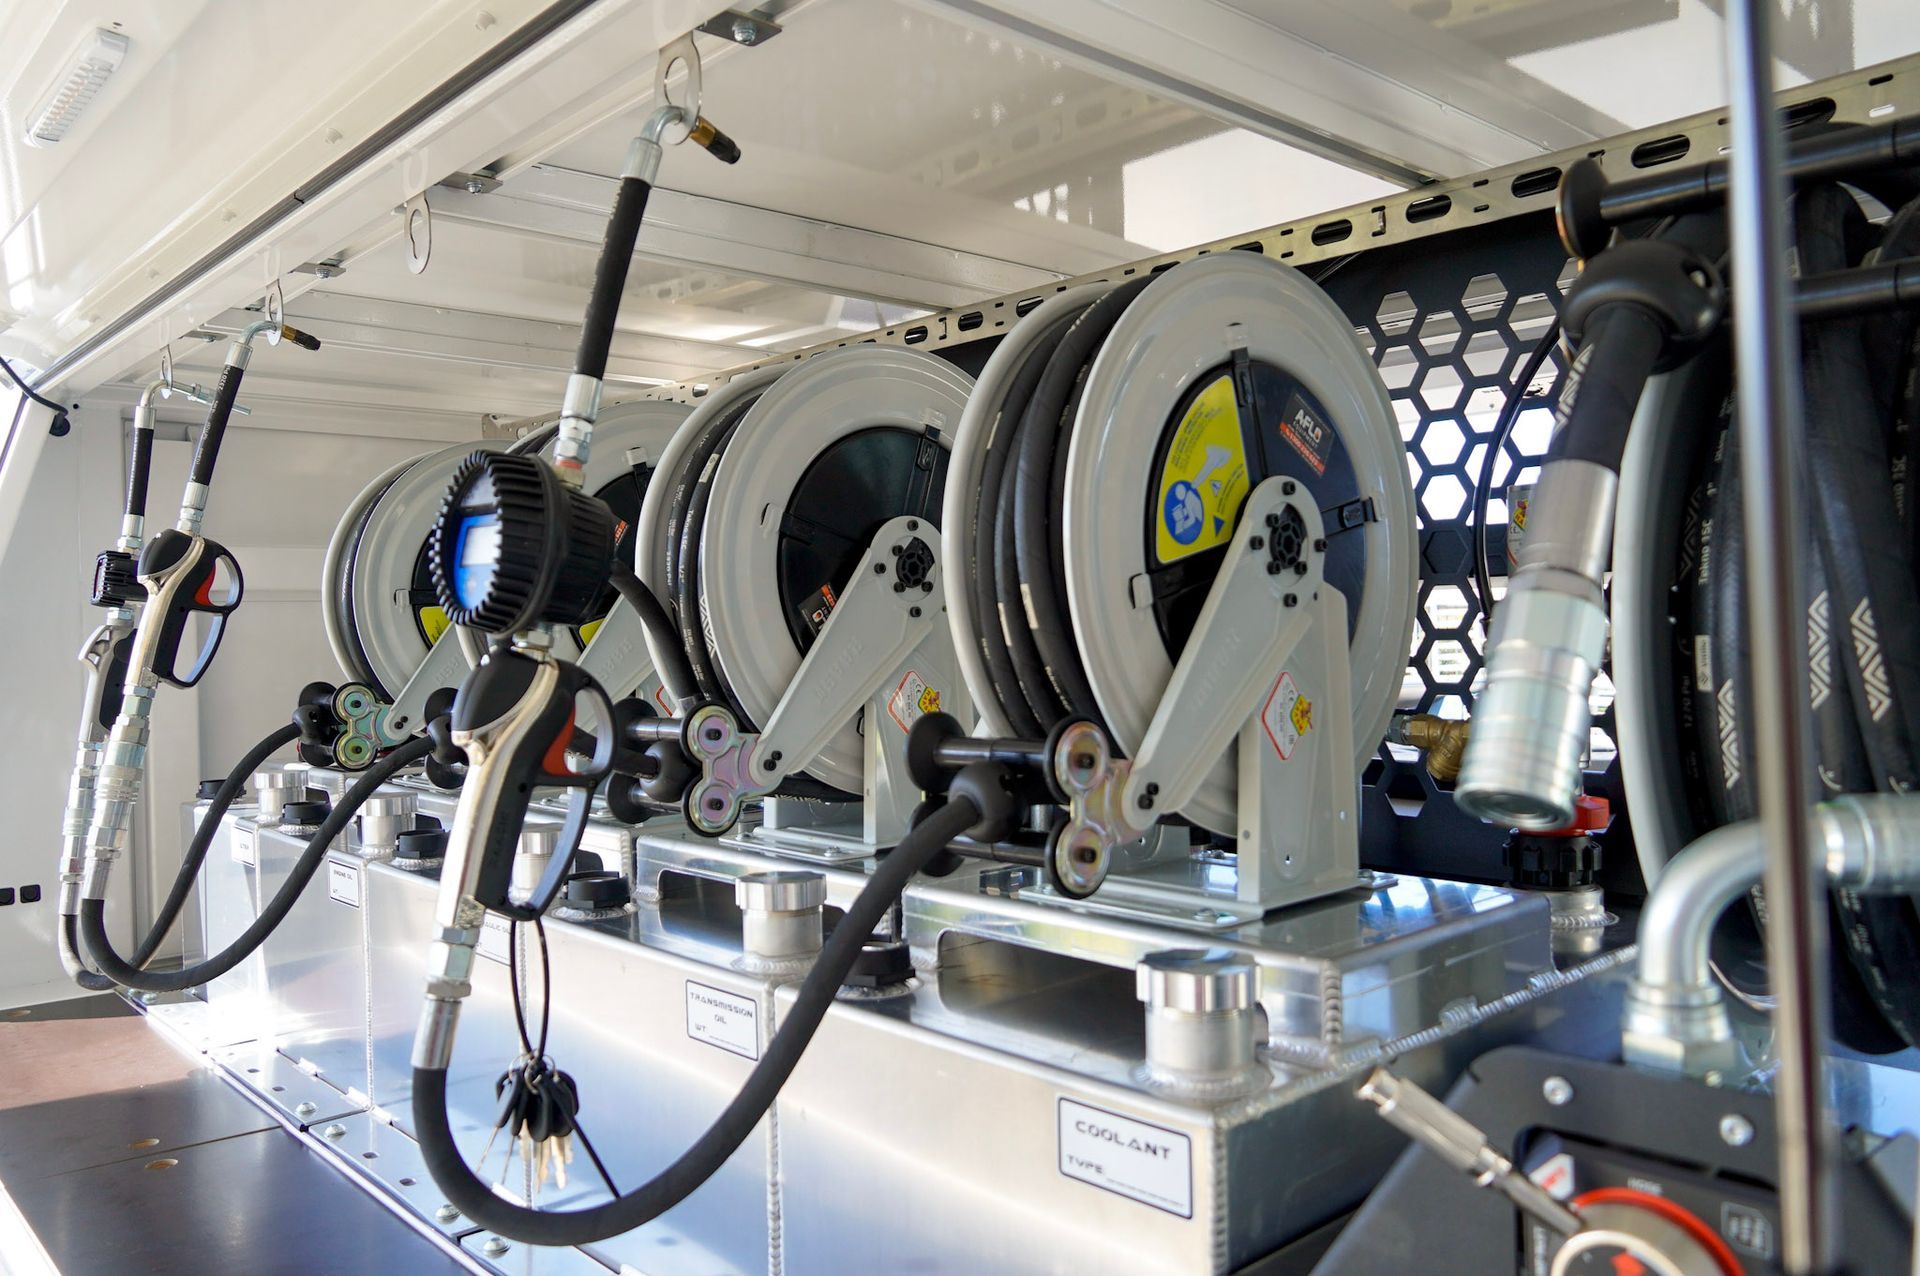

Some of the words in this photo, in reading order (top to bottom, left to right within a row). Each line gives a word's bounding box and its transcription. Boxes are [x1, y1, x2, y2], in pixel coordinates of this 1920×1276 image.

[1294, 408, 1322, 443] AFLO
[1698, 545, 1710, 586] Tekno
[690, 991, 753, 1018] TRANSMISSION
[695, 1023, 706, 1032] WT
[714, 1014, 727, 1025] OIL
[1074, 1120, 1171, 1160] COOLANT
[1066, 1155, 1104, 1175] TYPE
